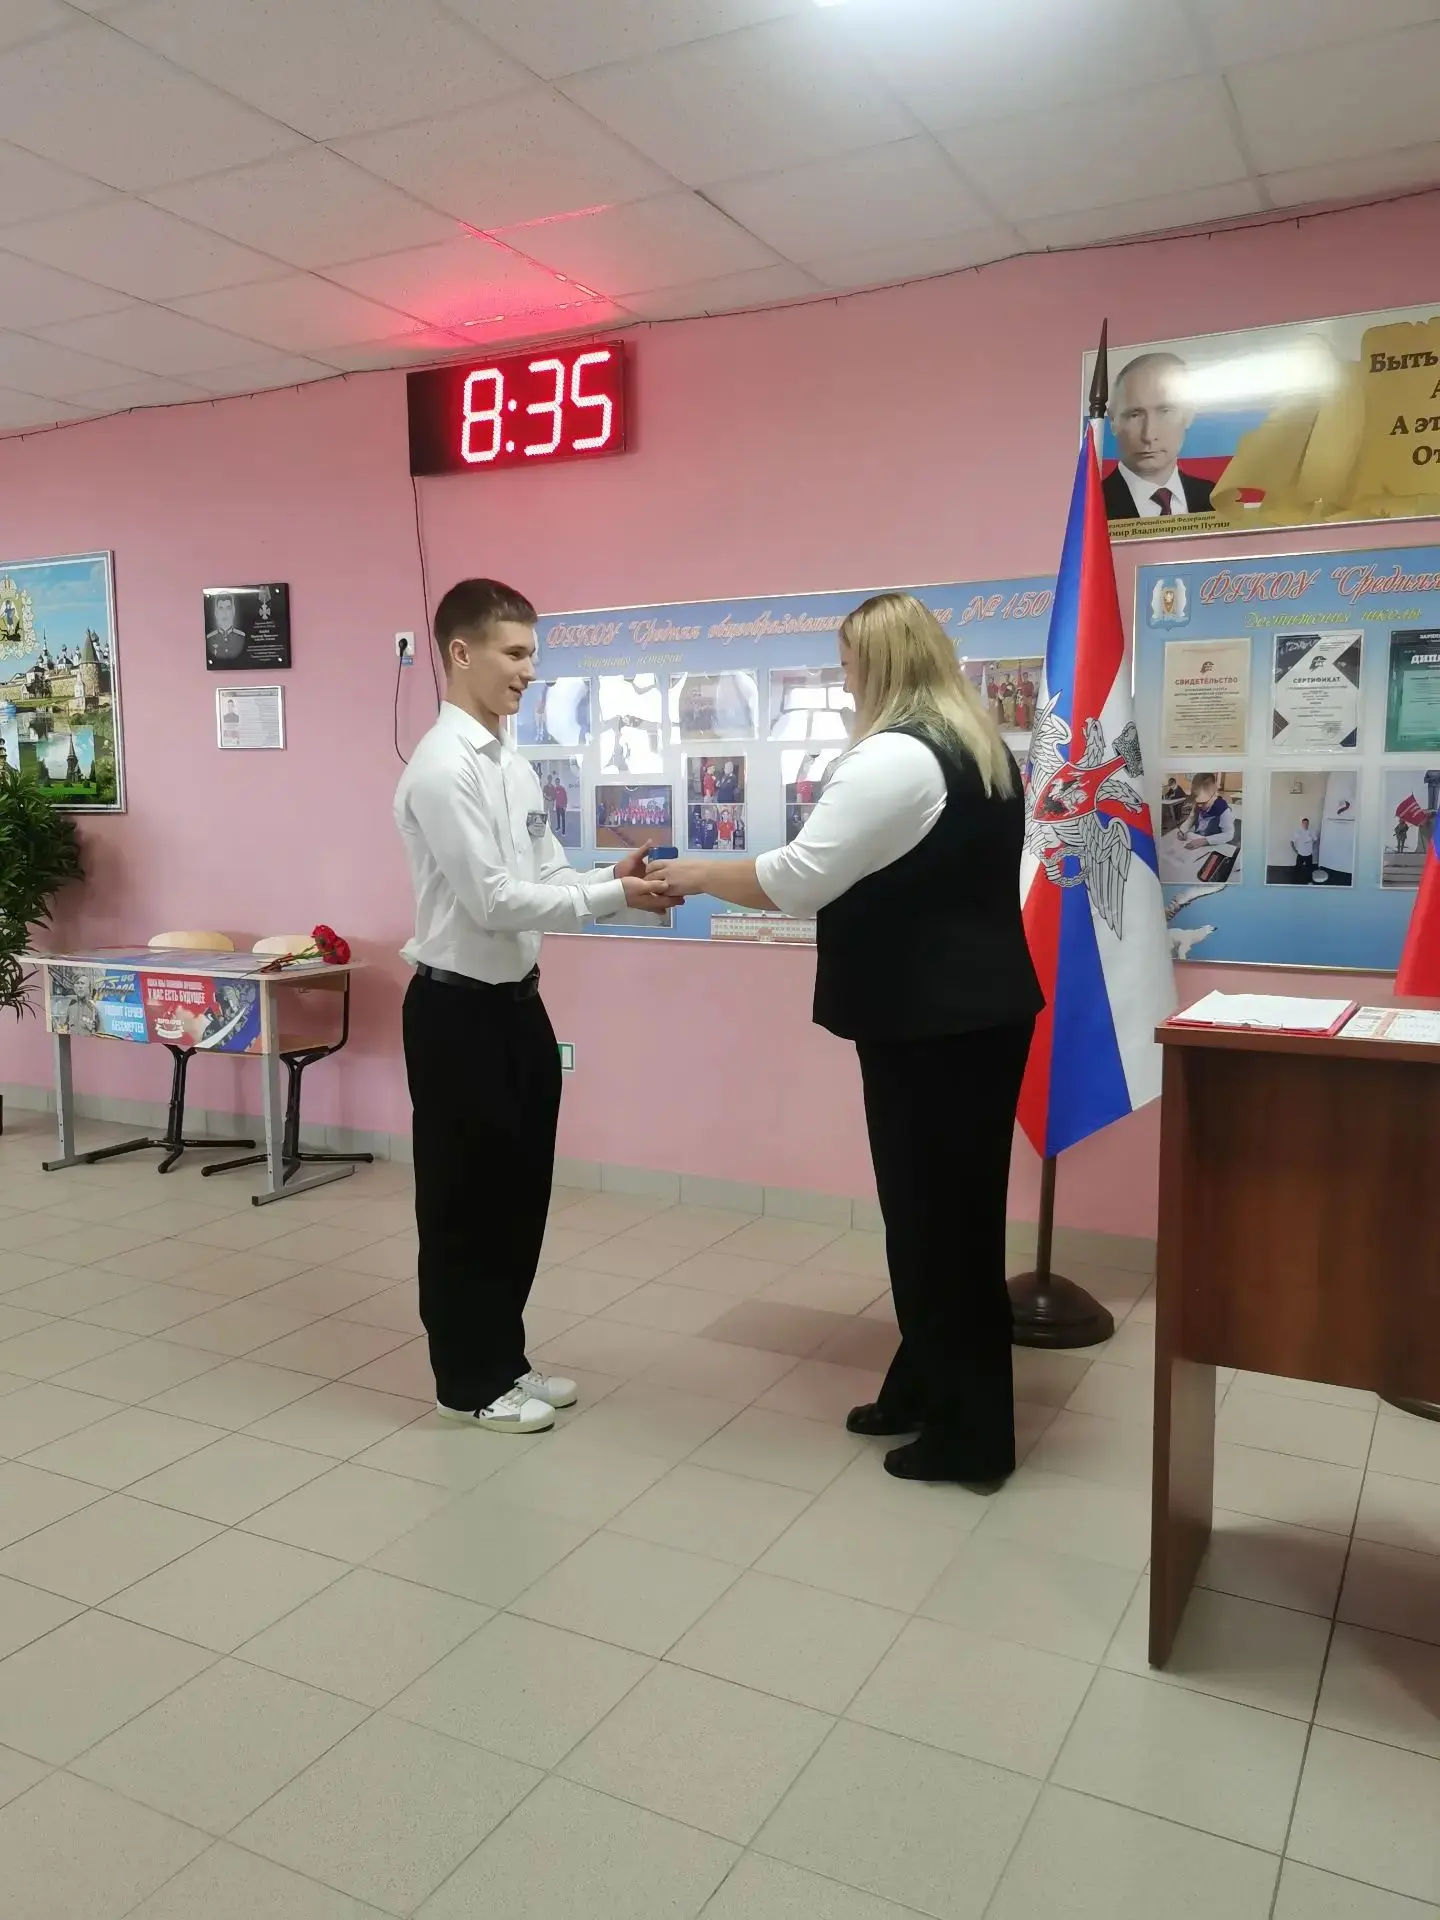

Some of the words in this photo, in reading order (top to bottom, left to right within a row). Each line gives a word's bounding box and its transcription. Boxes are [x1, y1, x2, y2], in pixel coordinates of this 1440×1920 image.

[1369, 351, 1439, 374] Быть
[461, 350, 613, 464] 8:35
[1389, 415, 1410, 436] А
[1176, 515, 1216, 523] Федерации
[1131, 523, 1199, 536] Владимирович
[1200, 521, 1230, 530] Путин
[1200, 568, 1322, 605] ФГКОУ
[1174, 677, 1239, 686] СВИДЕТЕЛЬСТВО
[1292, 676, 1341, 684] СЕРТИФИКАТ
